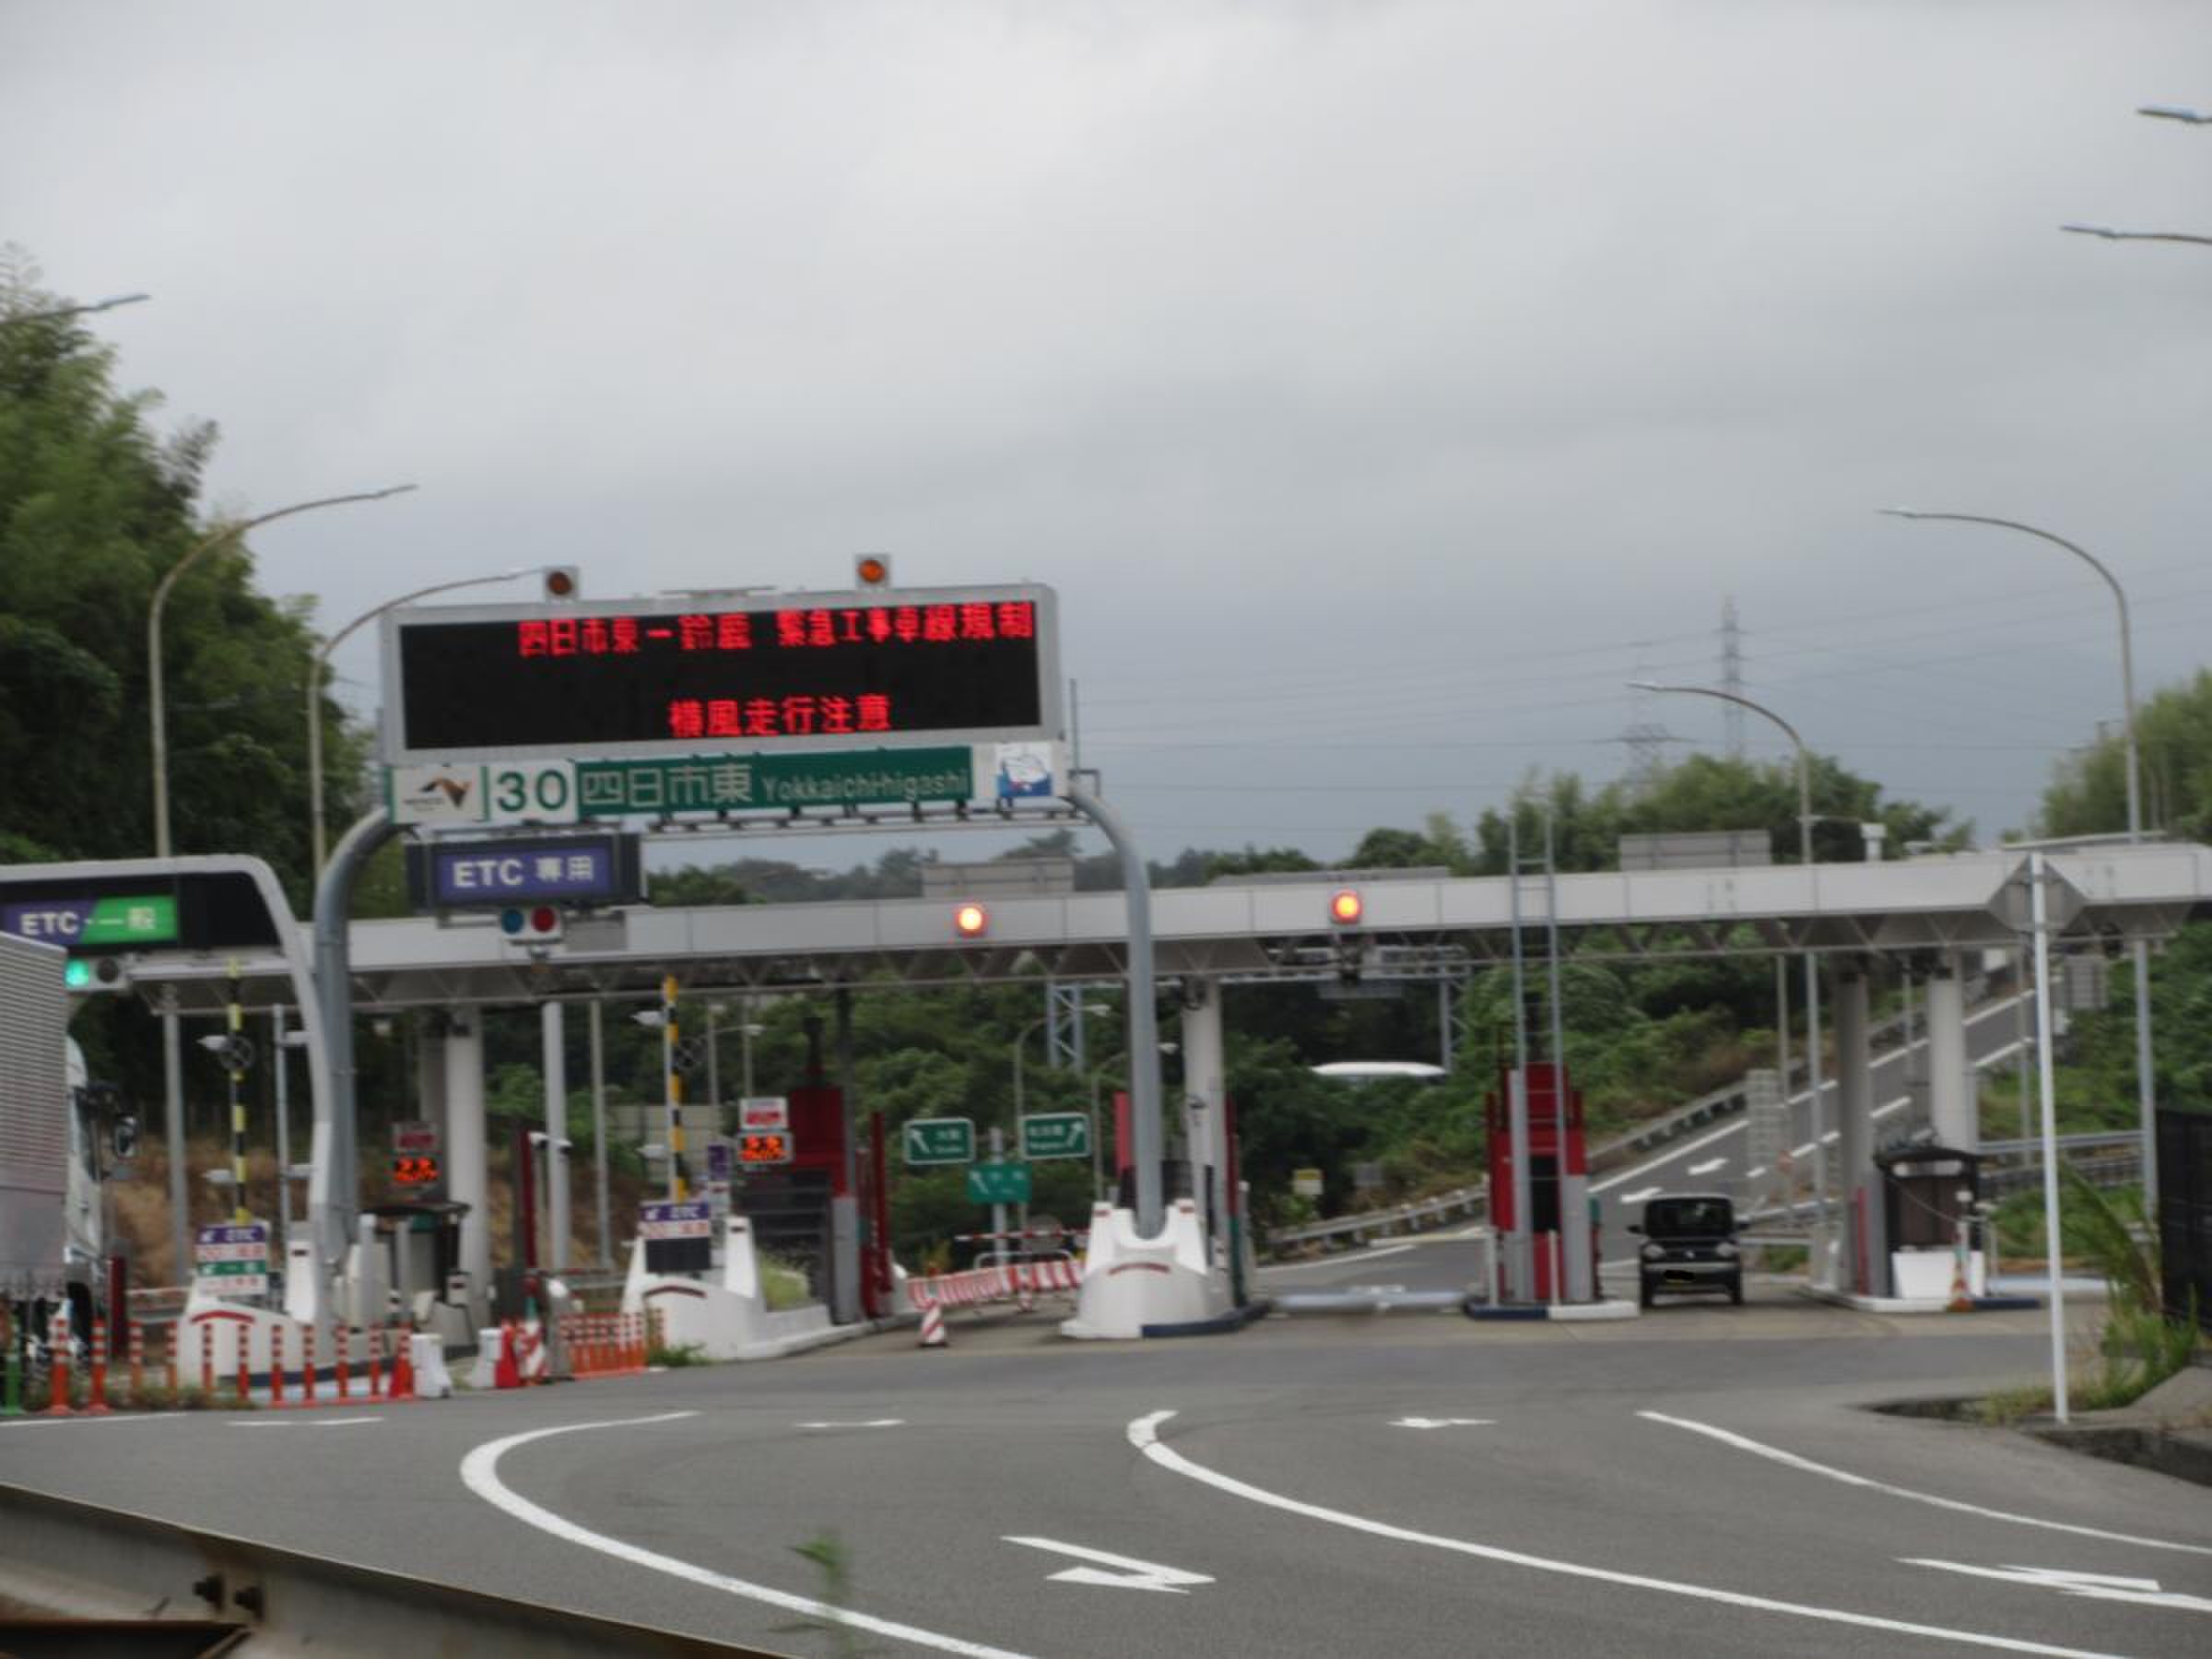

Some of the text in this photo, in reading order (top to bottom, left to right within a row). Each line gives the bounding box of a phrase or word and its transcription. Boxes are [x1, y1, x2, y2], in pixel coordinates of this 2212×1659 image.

[668, 693, 890, 738] 横風走行注意
[496, 770, 569, 811] 30
[582, 764, 753, 808] 四日市東
[453, 855, 594, 888] ETC 専用
